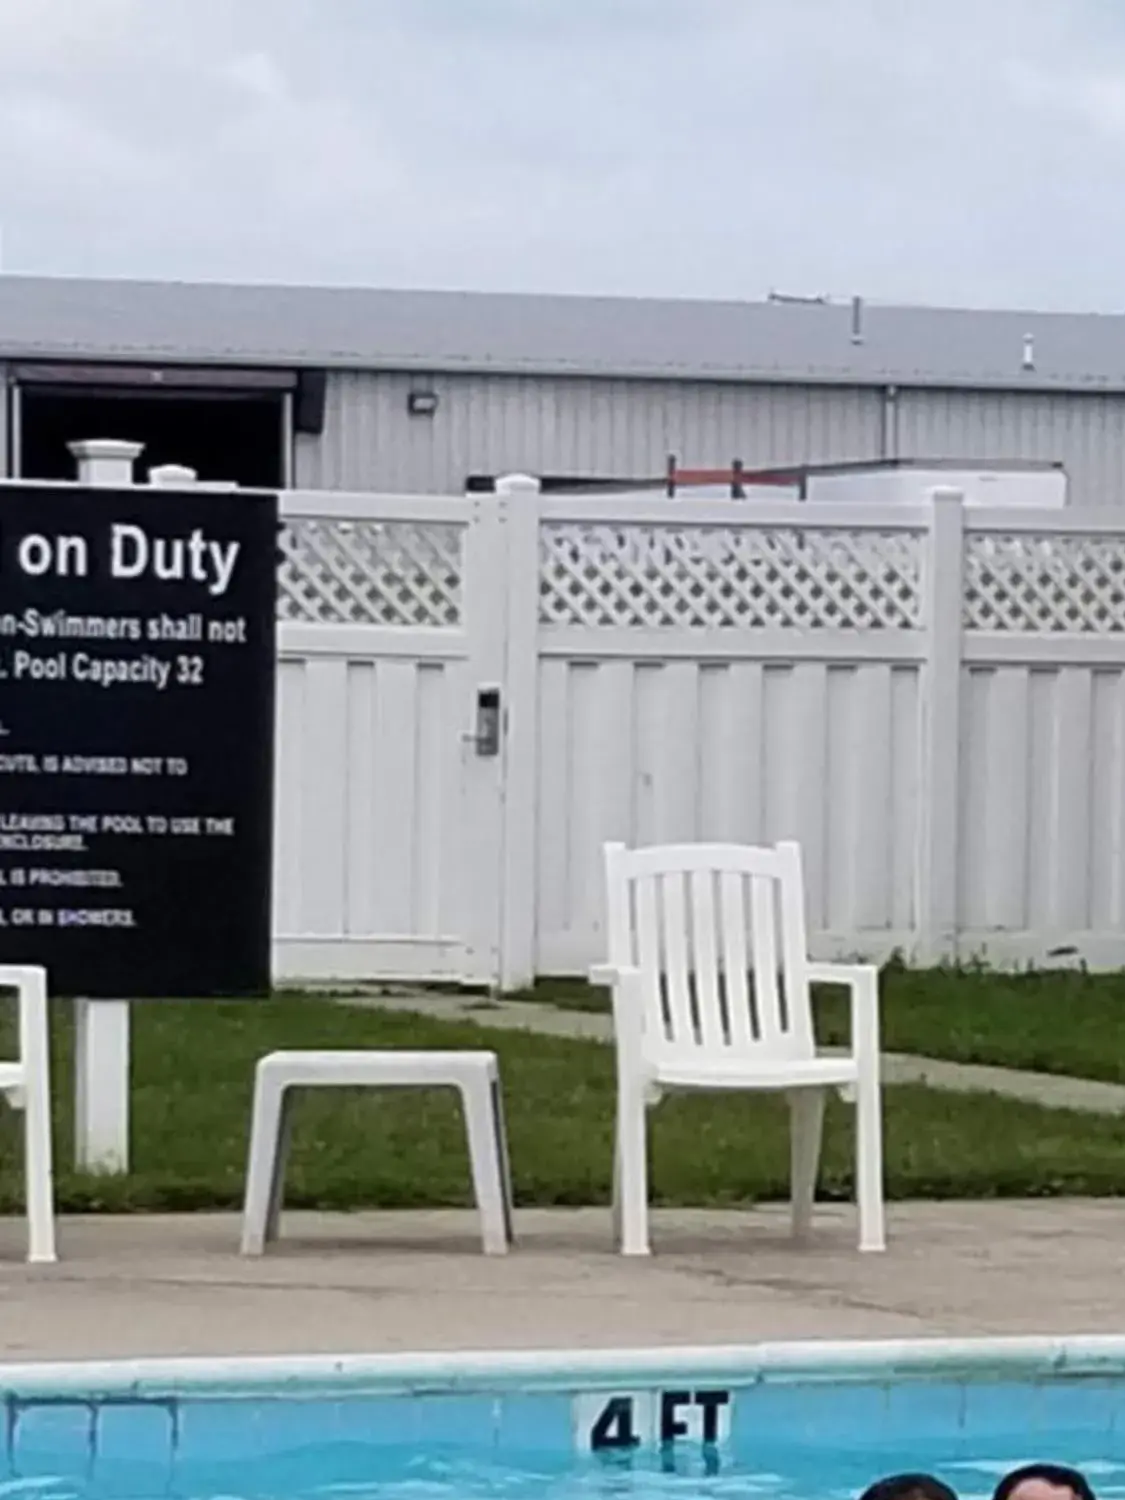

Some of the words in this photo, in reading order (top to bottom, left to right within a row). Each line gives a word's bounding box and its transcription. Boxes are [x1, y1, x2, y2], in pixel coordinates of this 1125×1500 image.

[18, 534, 87, 576] on
[111, 523, 240, 595] Duty
[148, 614, 202, 640] shall
[208, 618, 246, 642] not
[14, 650, 66, 679] Pool
[72, 653, 170, 689] Capacity
[177, 655, 203, 684] 32
[167, 758, 187, 775] TO
[69, 815, 97, 832] THE
[102, 816, 143, 833] POOL
[147, 816, 167, 833] TO
[206, 818, 233, 834] THE
[590, 1396, 641, 1453] 4
[661, 1390, 730, 1477] FT
